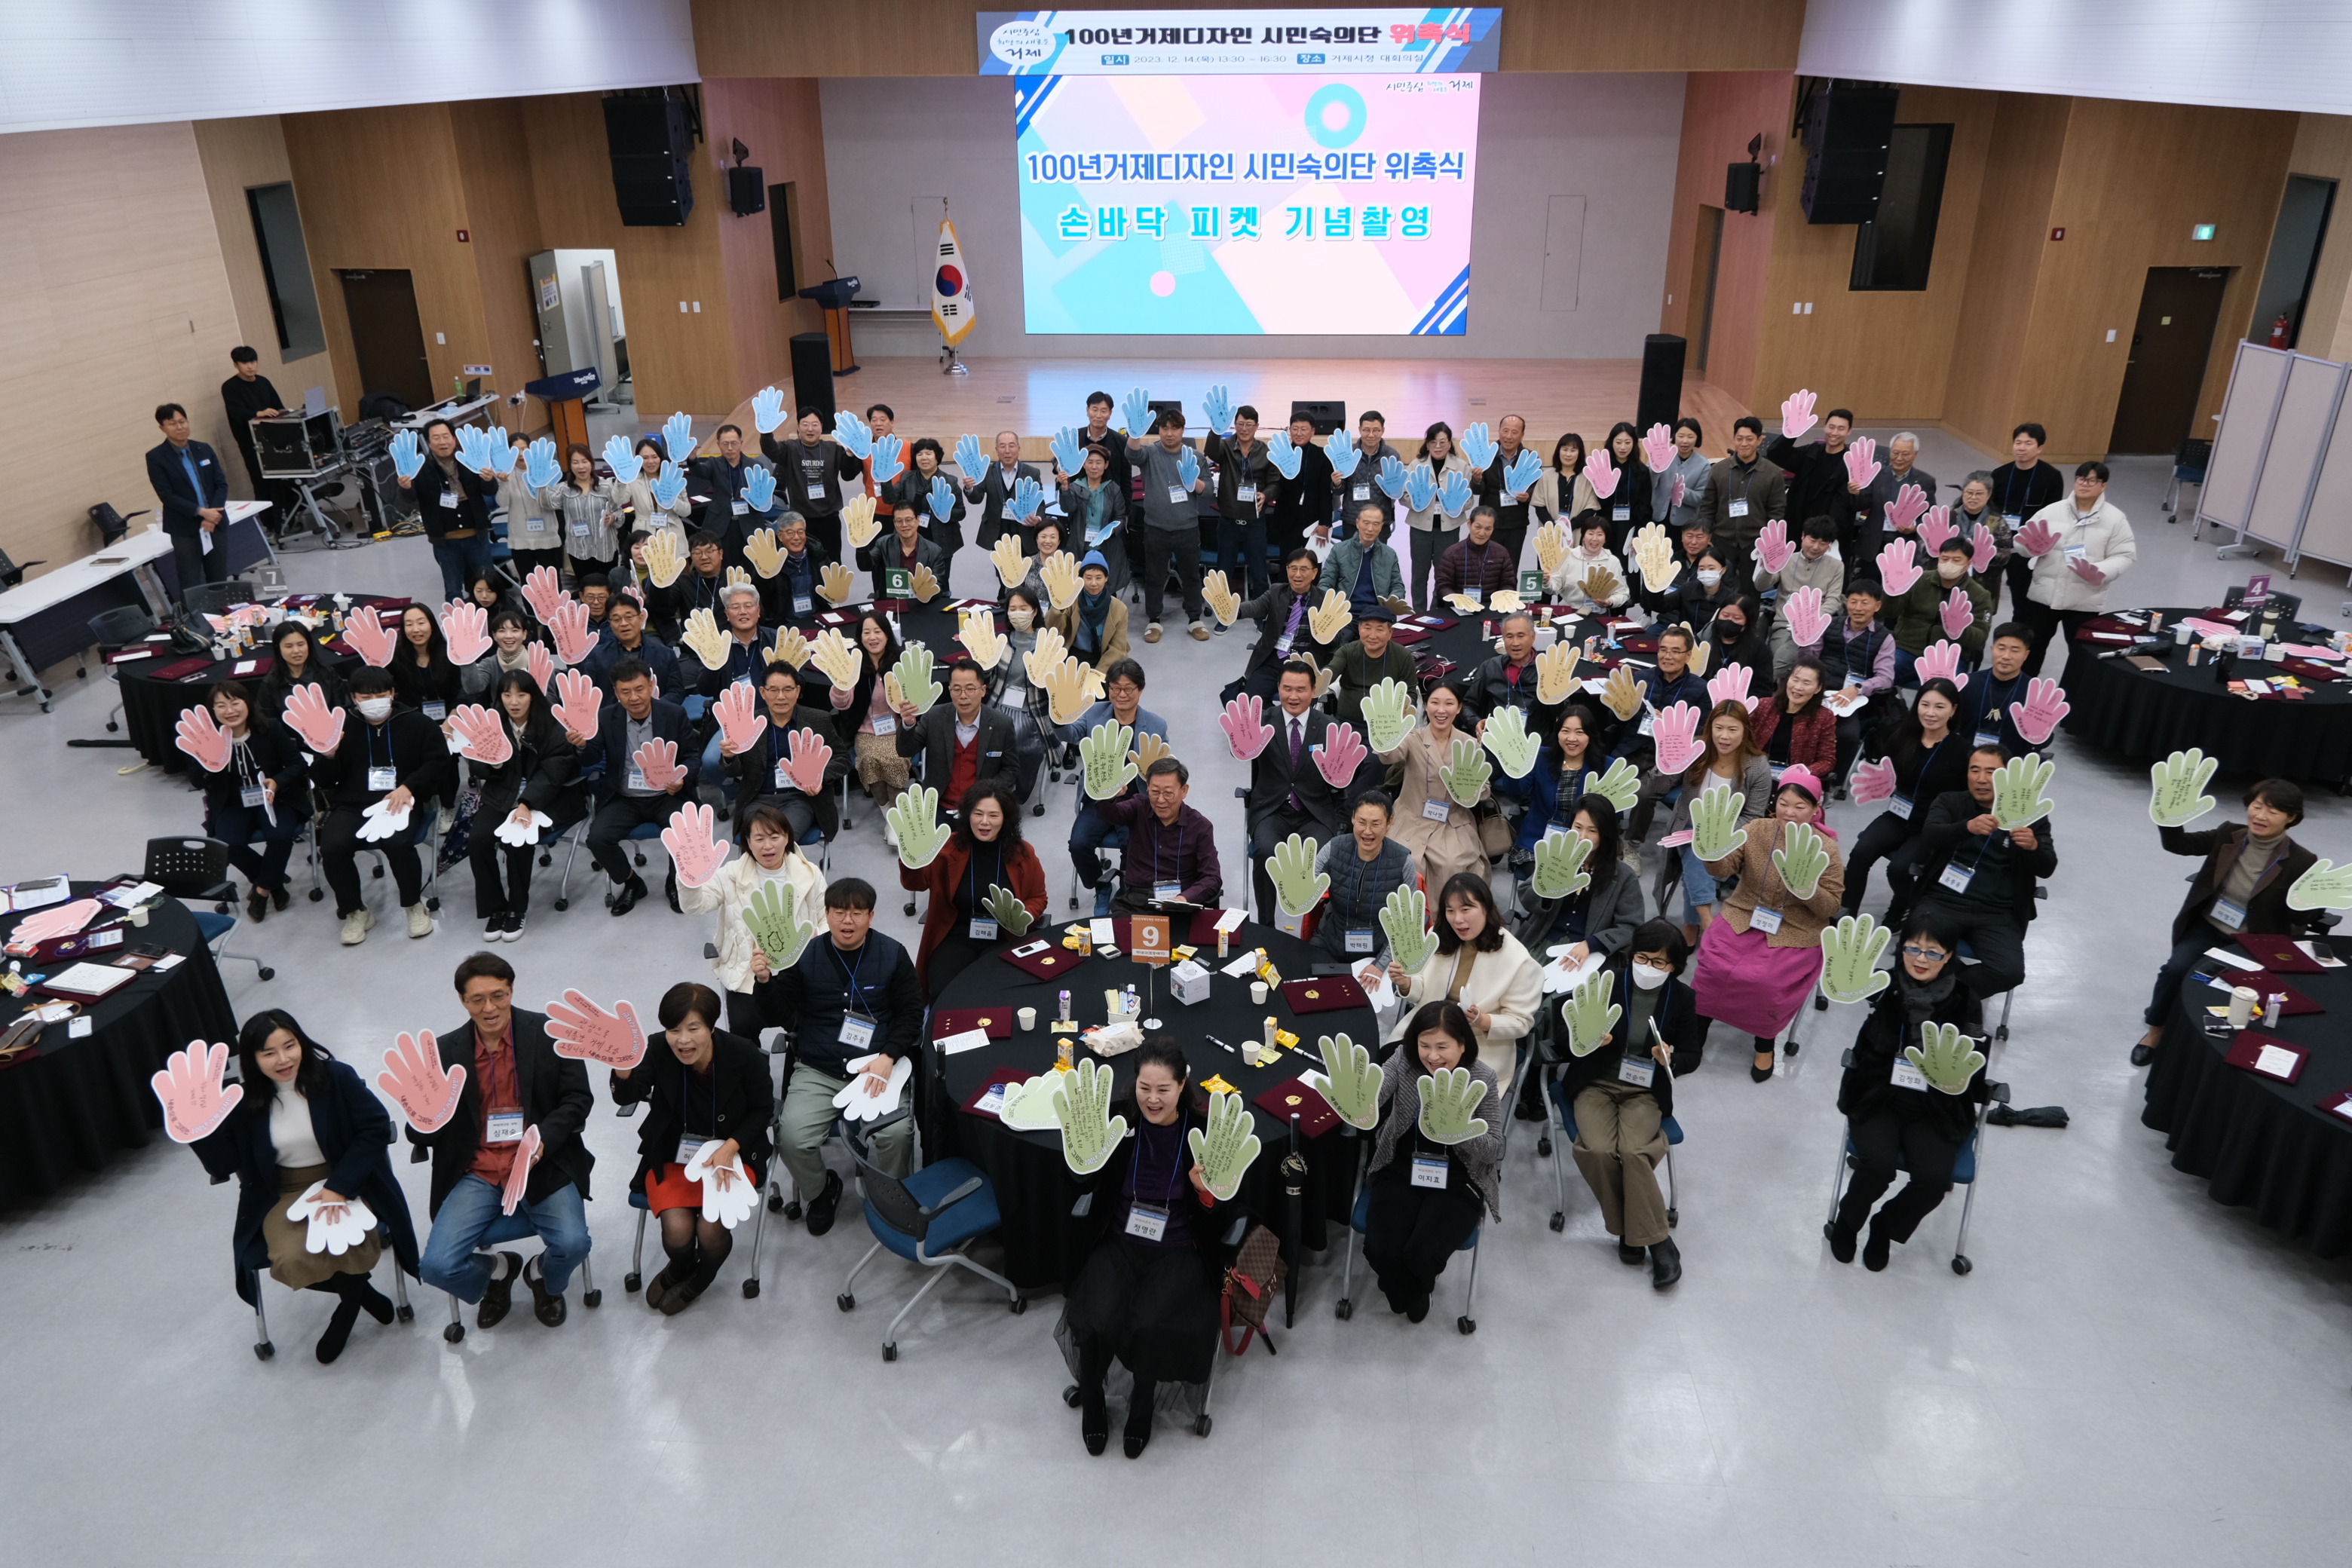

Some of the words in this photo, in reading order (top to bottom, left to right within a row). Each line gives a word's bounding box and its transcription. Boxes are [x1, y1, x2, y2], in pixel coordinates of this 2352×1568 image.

[1003, 28, 1040, 36] 시민중심
[1064, 27, 1253, 44] 100년거제디자인
[1261, 26, 1383, 44] 시민숙의단
[1389, 22, 1471, 44] 위촉식
[1004, 47, 1042, 60] 거제
[1104, 55, 1128, 65] 일시
[1300, 54, 1323, 63] 장소
[1331, 54, 1375, 63] 거제시청
[1380, 54, 1424, 63] 대회의실
[1386, 81, 1424, 92] 시민중심
[1449, 79, 1474, 92] 거제
[1027, 152, 1234, 182] 100년거제디자인
[1242, 152, 1377, 181] 시민숙의단
[1384, 151, 1465, 180] 위촉식
[1058, 204, 1168, 238] 손바닥
[1191, 204, 1262, 238] 피켓
[1285, 204, 1432, 237] 기념촬영
[266, 571, 276, 584] 7
[892, 574, 902, 587] 6
[1526, 577, 1536, 590] 5
[2250, 581, 2263, 595] 4
[1230, 733, 1238, 749] 내손으로
[676, 851, 684, 871] 내손으로
[905, 852, 917, 863] 그리는
[1279, 880, 1287, 902] 내손으로
[1285, 899, 1296, 911] 그리는
[1142, 926, 1159, 947] 9
[1392, 934, 1400, 957] 내손으로
[590, 1038, 605, 1052] 거제
[588, 1050, 614, 1062] 내손으로
[617, 1054, 635, 1064] 그리는
[401, 1095, 418, 1119] 내손으로
[417, 1115, 433, 1125] 그리는
[446, 1092, 455, 1109] 거제
[1064, 1122, 1074, 1153] 내손으로
[1070, 1152, 1084, 1167] 그리는
[1418, 1174, 1440, 1184] 이지효
[1133, 1223, 1156, 1236] 정명란
